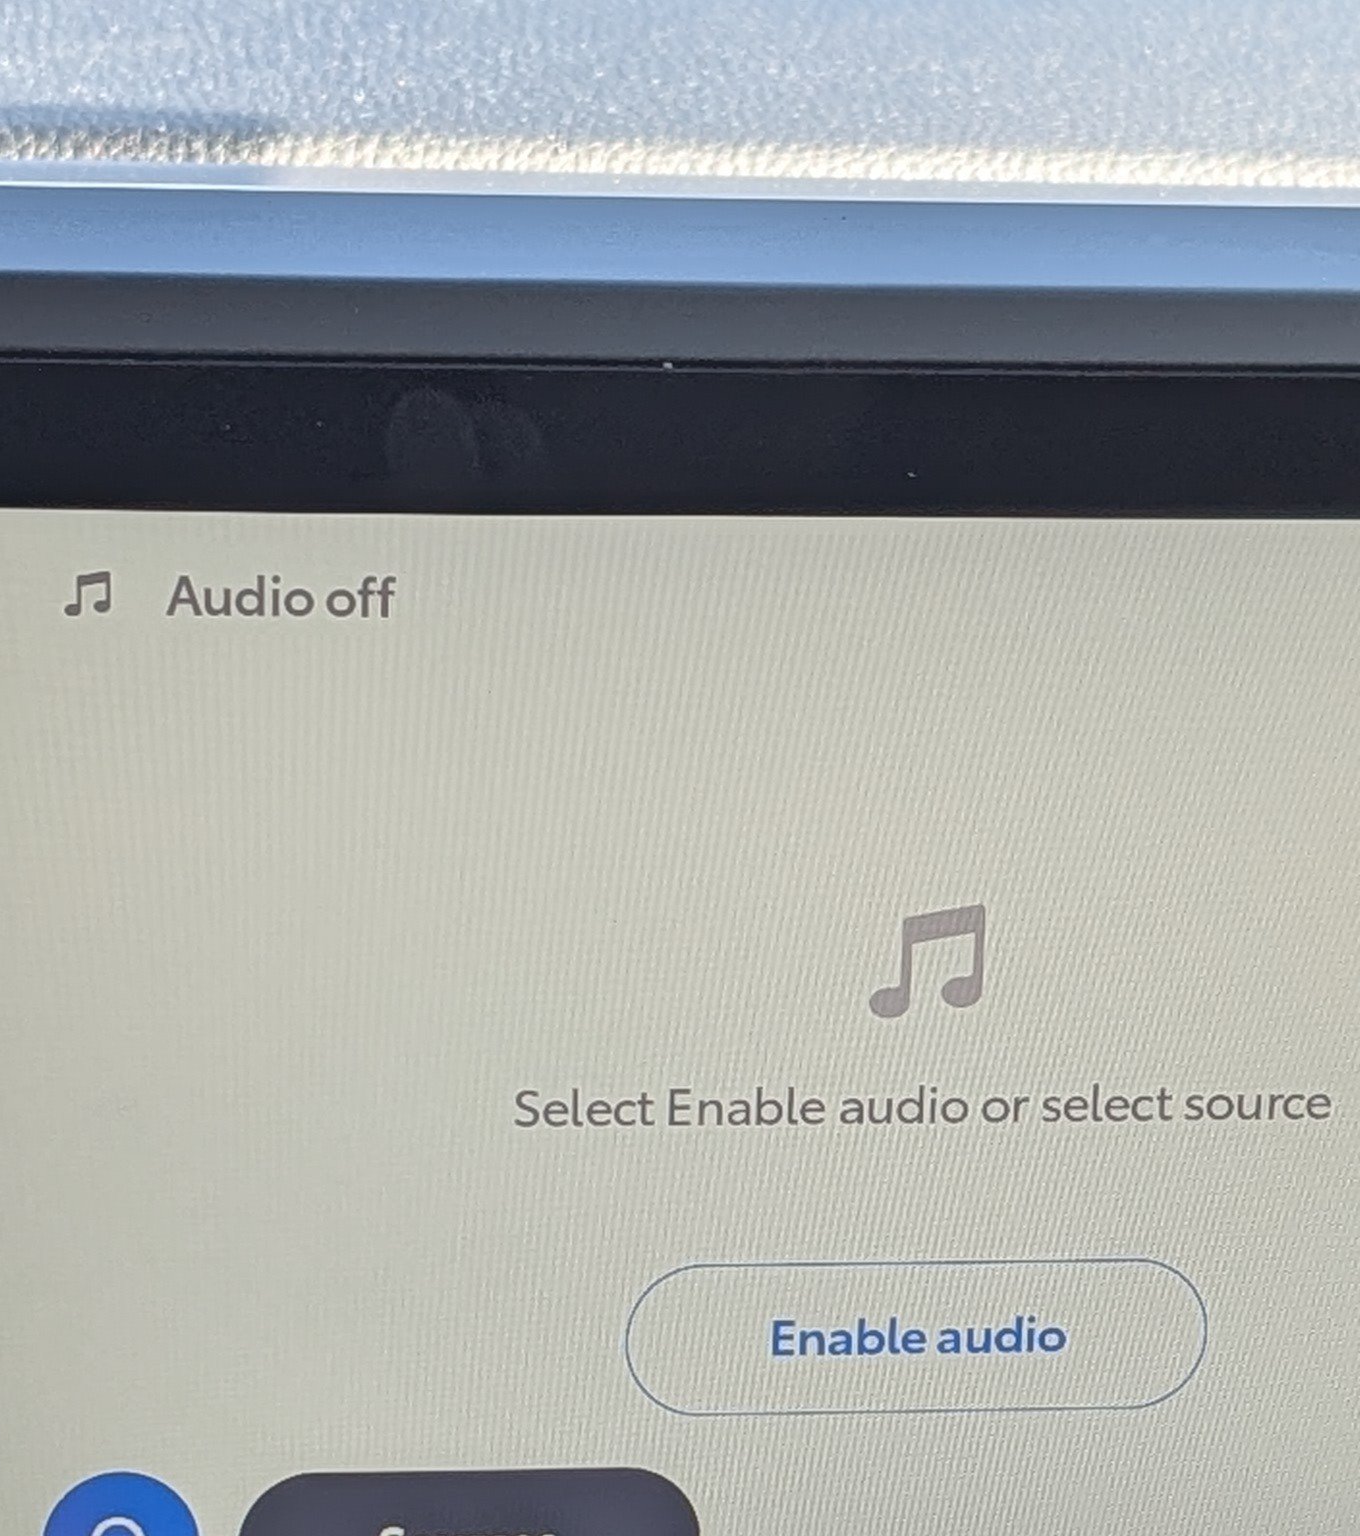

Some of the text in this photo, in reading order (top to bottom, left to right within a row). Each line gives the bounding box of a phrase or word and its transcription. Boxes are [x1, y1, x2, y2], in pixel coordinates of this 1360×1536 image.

[165, 574, 397, 619] Audio off
[513, 1083, 1333, 1130] Select Enable audio or select source
[770, 1315, 1067, 1357] Enable audio
